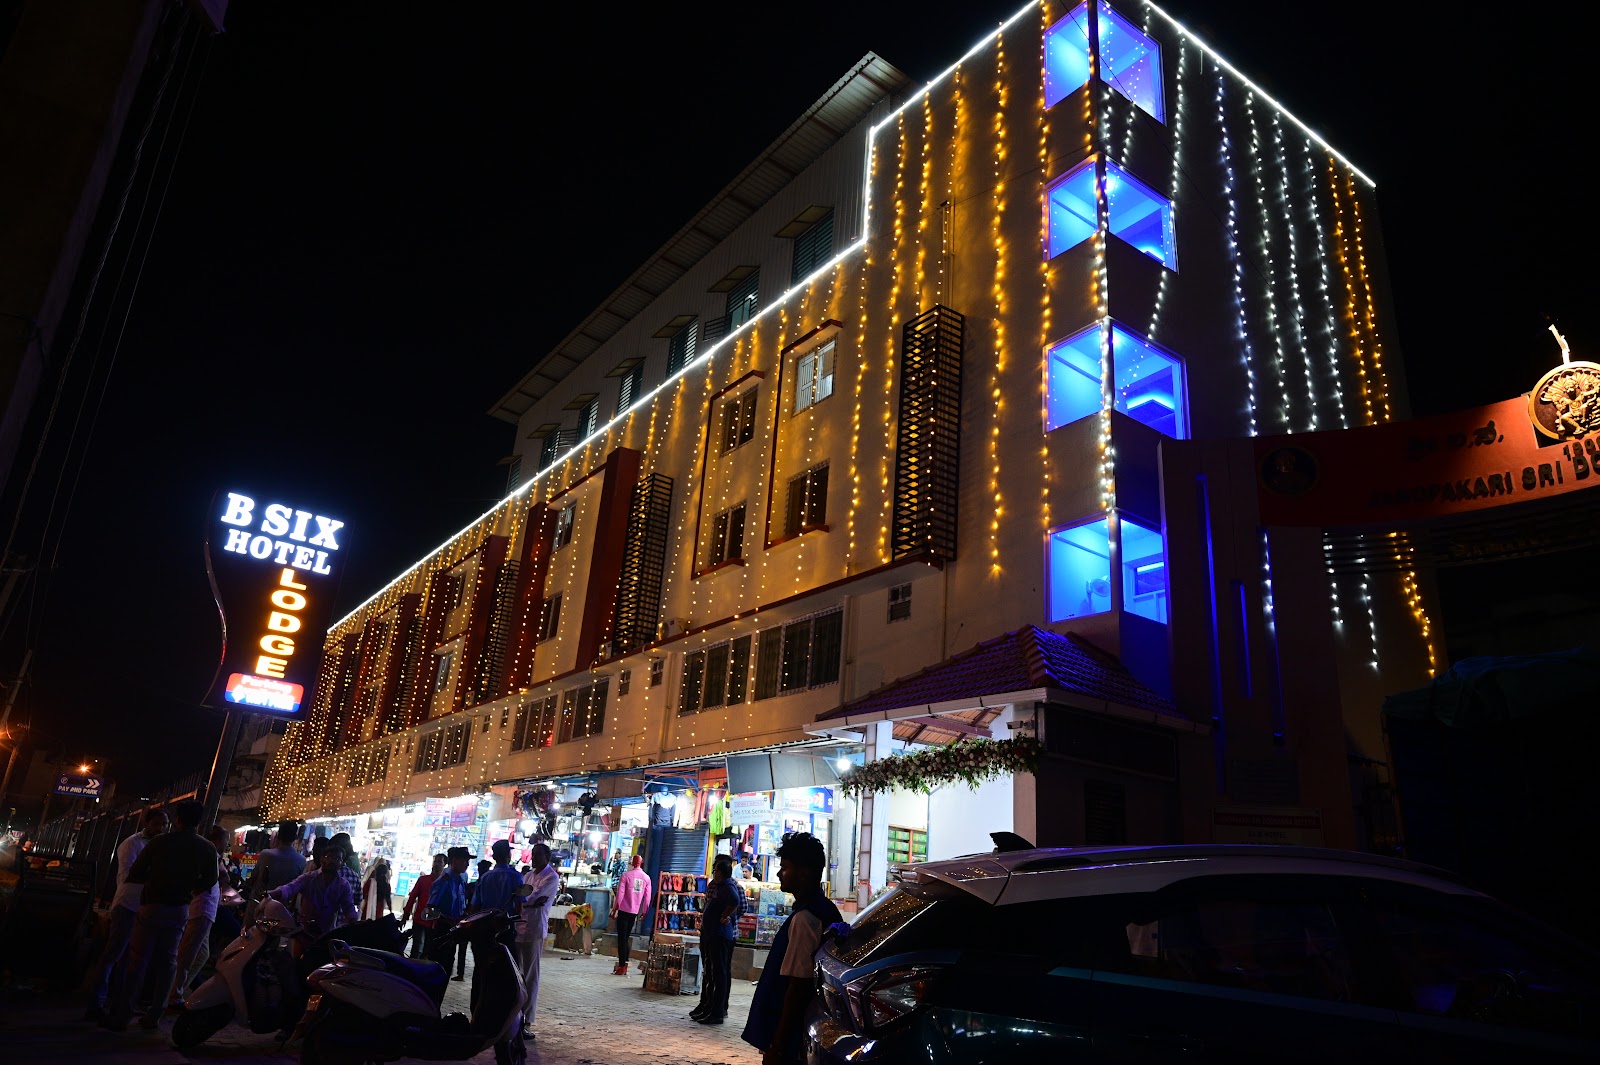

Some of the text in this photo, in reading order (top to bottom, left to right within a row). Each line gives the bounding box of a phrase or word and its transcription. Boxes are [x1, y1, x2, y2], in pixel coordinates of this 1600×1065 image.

[1521, 460, 1564, 490] SRI
[220, 492, 344, 550] B SIX
[223, 529, 332, 576] HOTEL
[255, 568, 307, 678] LODGE
[82, 788, 98, 796] PARK
